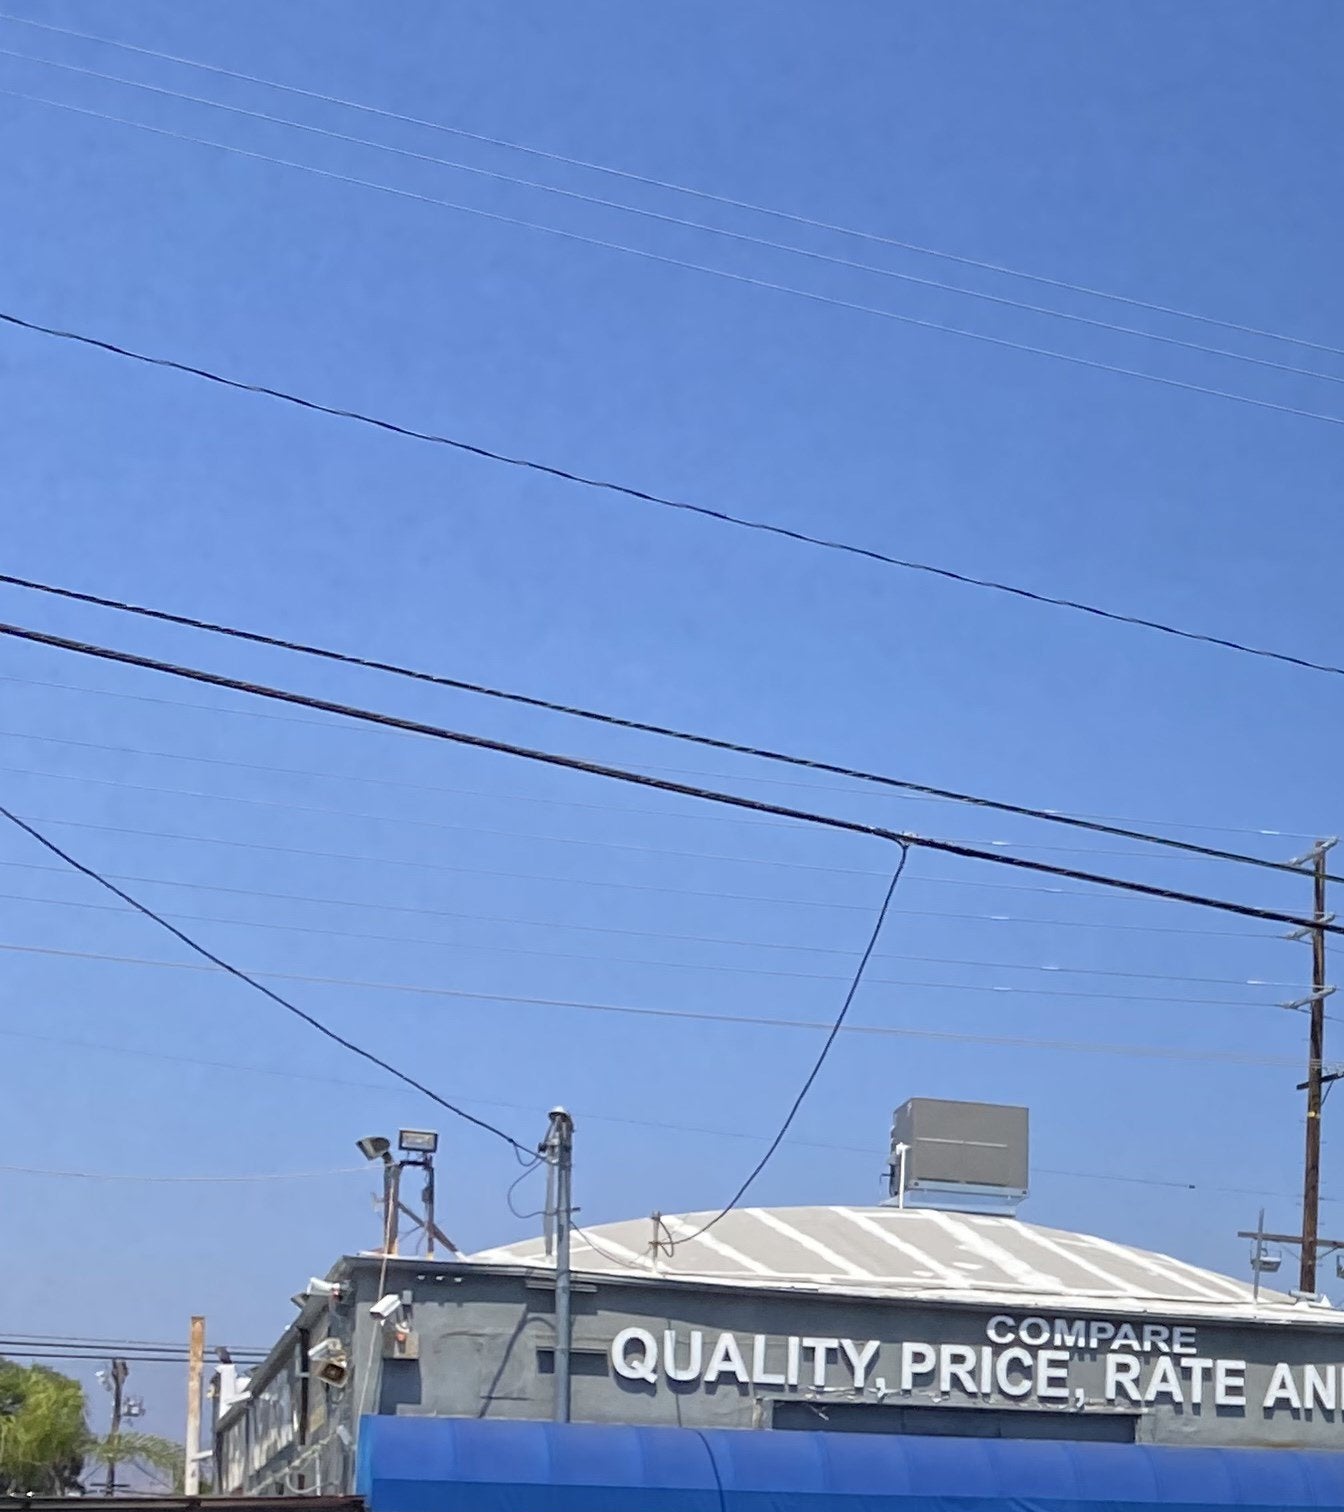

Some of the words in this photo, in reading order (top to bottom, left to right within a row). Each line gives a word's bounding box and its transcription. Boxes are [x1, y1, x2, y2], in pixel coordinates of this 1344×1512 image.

[986, 1315, 1197, 1354] COMPARE
[610, 1326, 886, 1400] QUALITY,
[901, 1342, 1084, 1408] PRICE,
[1104, 1353, 1247, 1406] RATE
